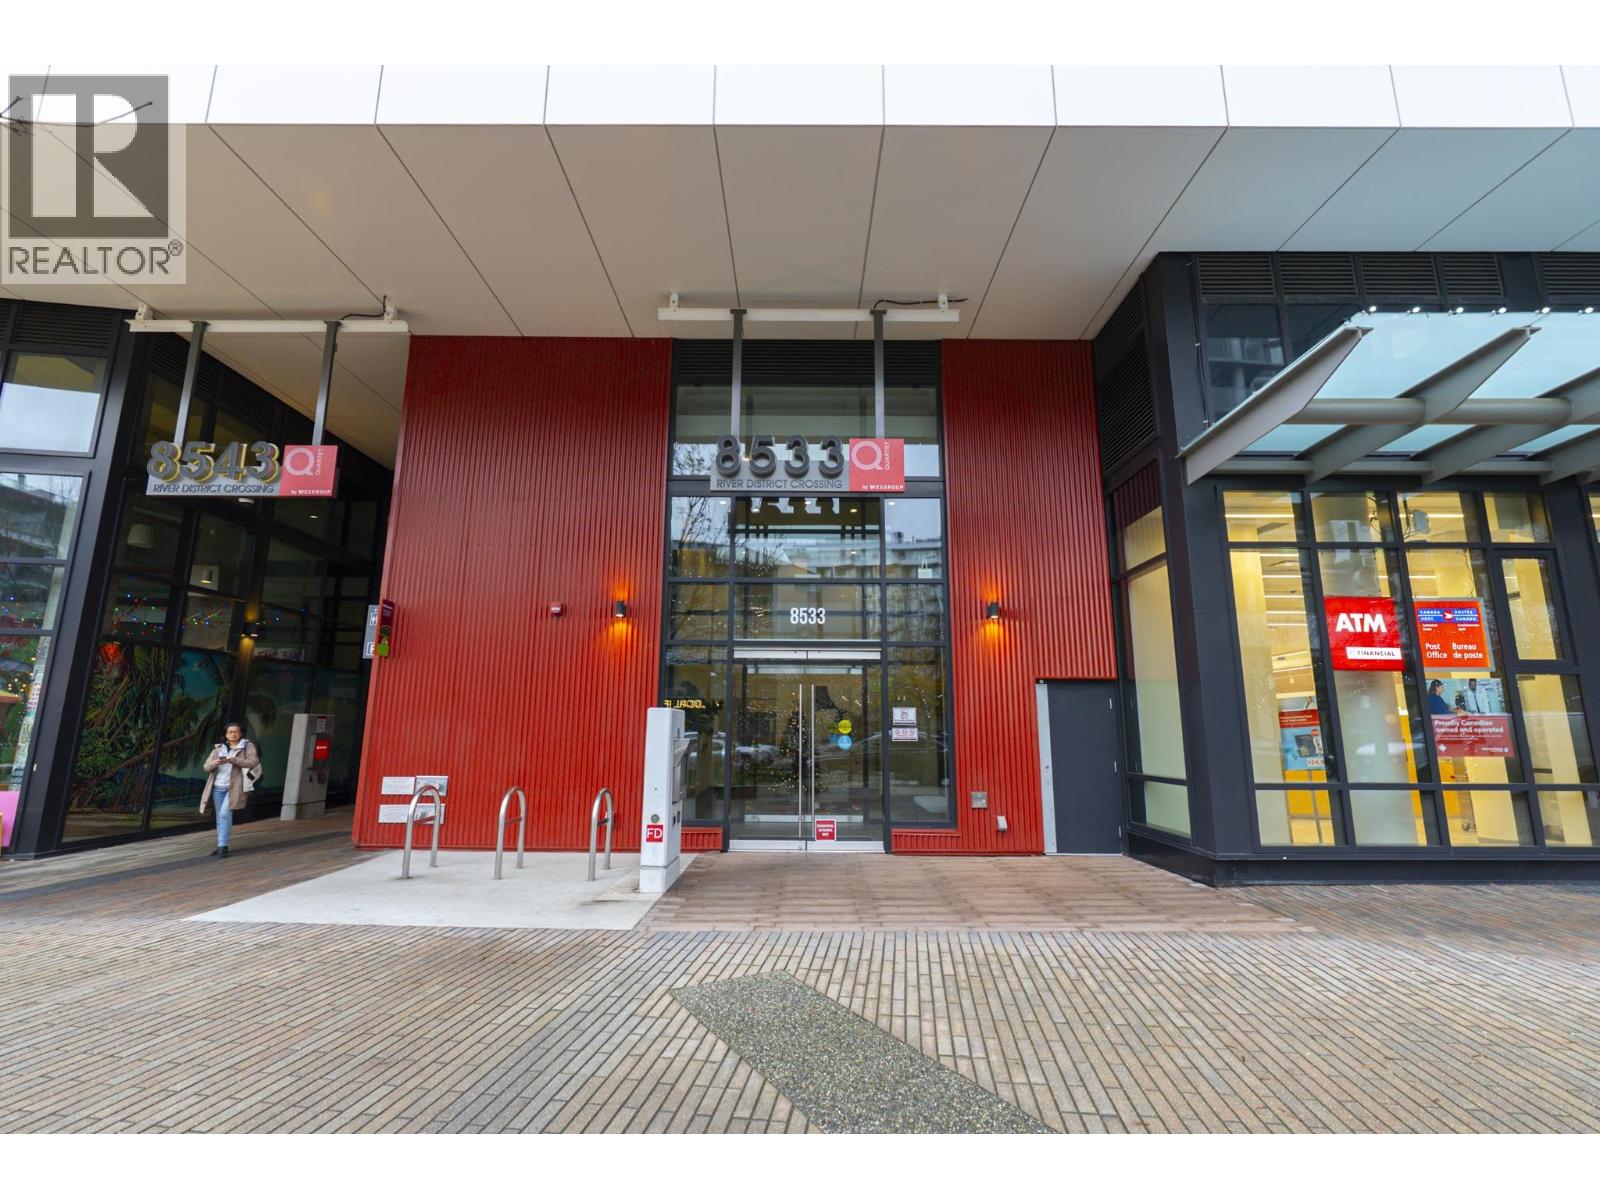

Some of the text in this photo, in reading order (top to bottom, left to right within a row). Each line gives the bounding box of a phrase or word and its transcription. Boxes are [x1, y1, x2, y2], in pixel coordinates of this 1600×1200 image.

[147, 441, 280, 482] 8543
[716, 434, 844, 477] 8533
[851, 440, 883, 470] Q
[153, 484, 274, 493] RIVER DISTRICT CROSSING
[716, 479, 843, 489] RIVER DISTRICT CROSSING
[790, 607, 826, 624] 8533
[1335, 612, 1387, 633] ATM
[1426, 651, 1448, 659] Office
[1453, 651, 1484, 660] de poste
[646, 828, 663, 839] FD
